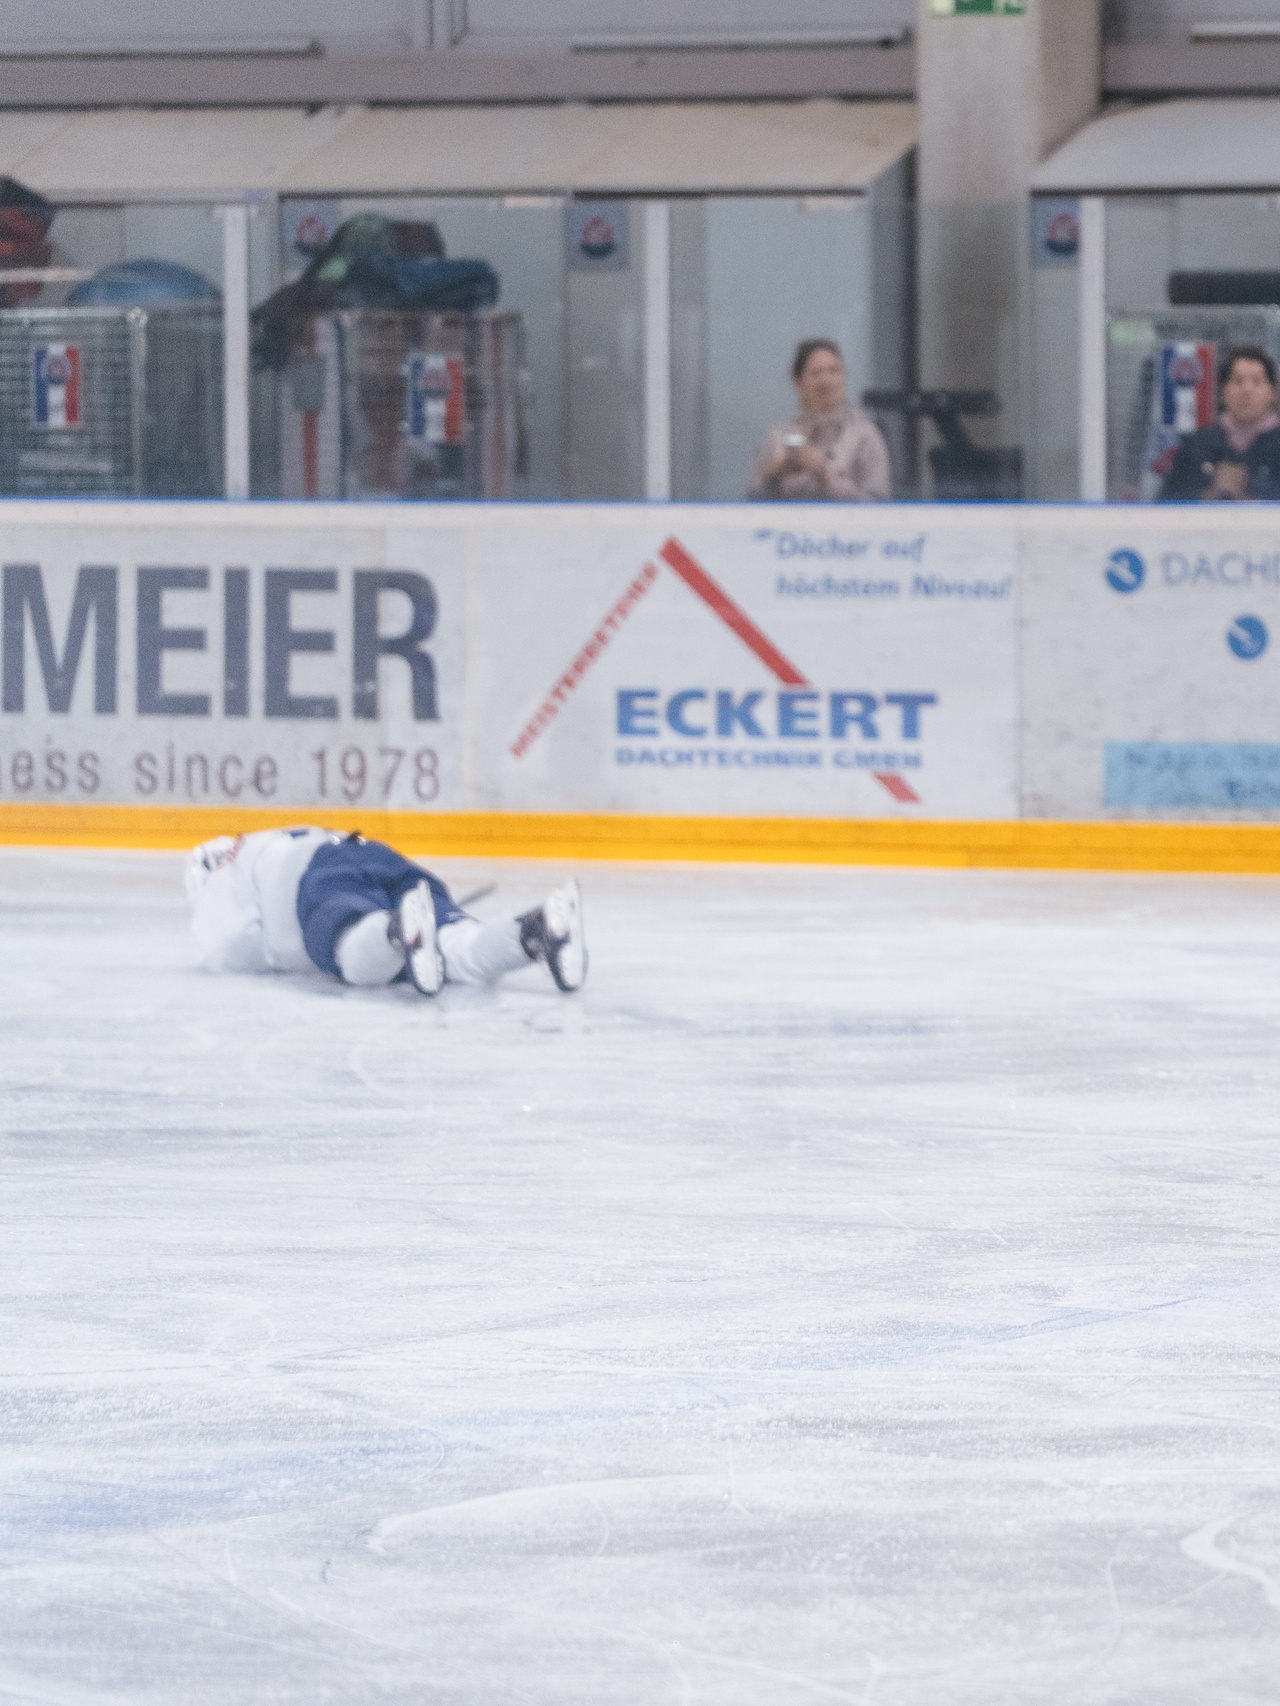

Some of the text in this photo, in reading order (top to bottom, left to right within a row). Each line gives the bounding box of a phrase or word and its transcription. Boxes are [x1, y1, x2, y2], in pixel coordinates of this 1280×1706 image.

[1, 563, 441, 721] MEIER
[615, 686, 938, 741] ECKERT
[134, 740, 279, 798] since
[310, 745, 441, 802] 1978
